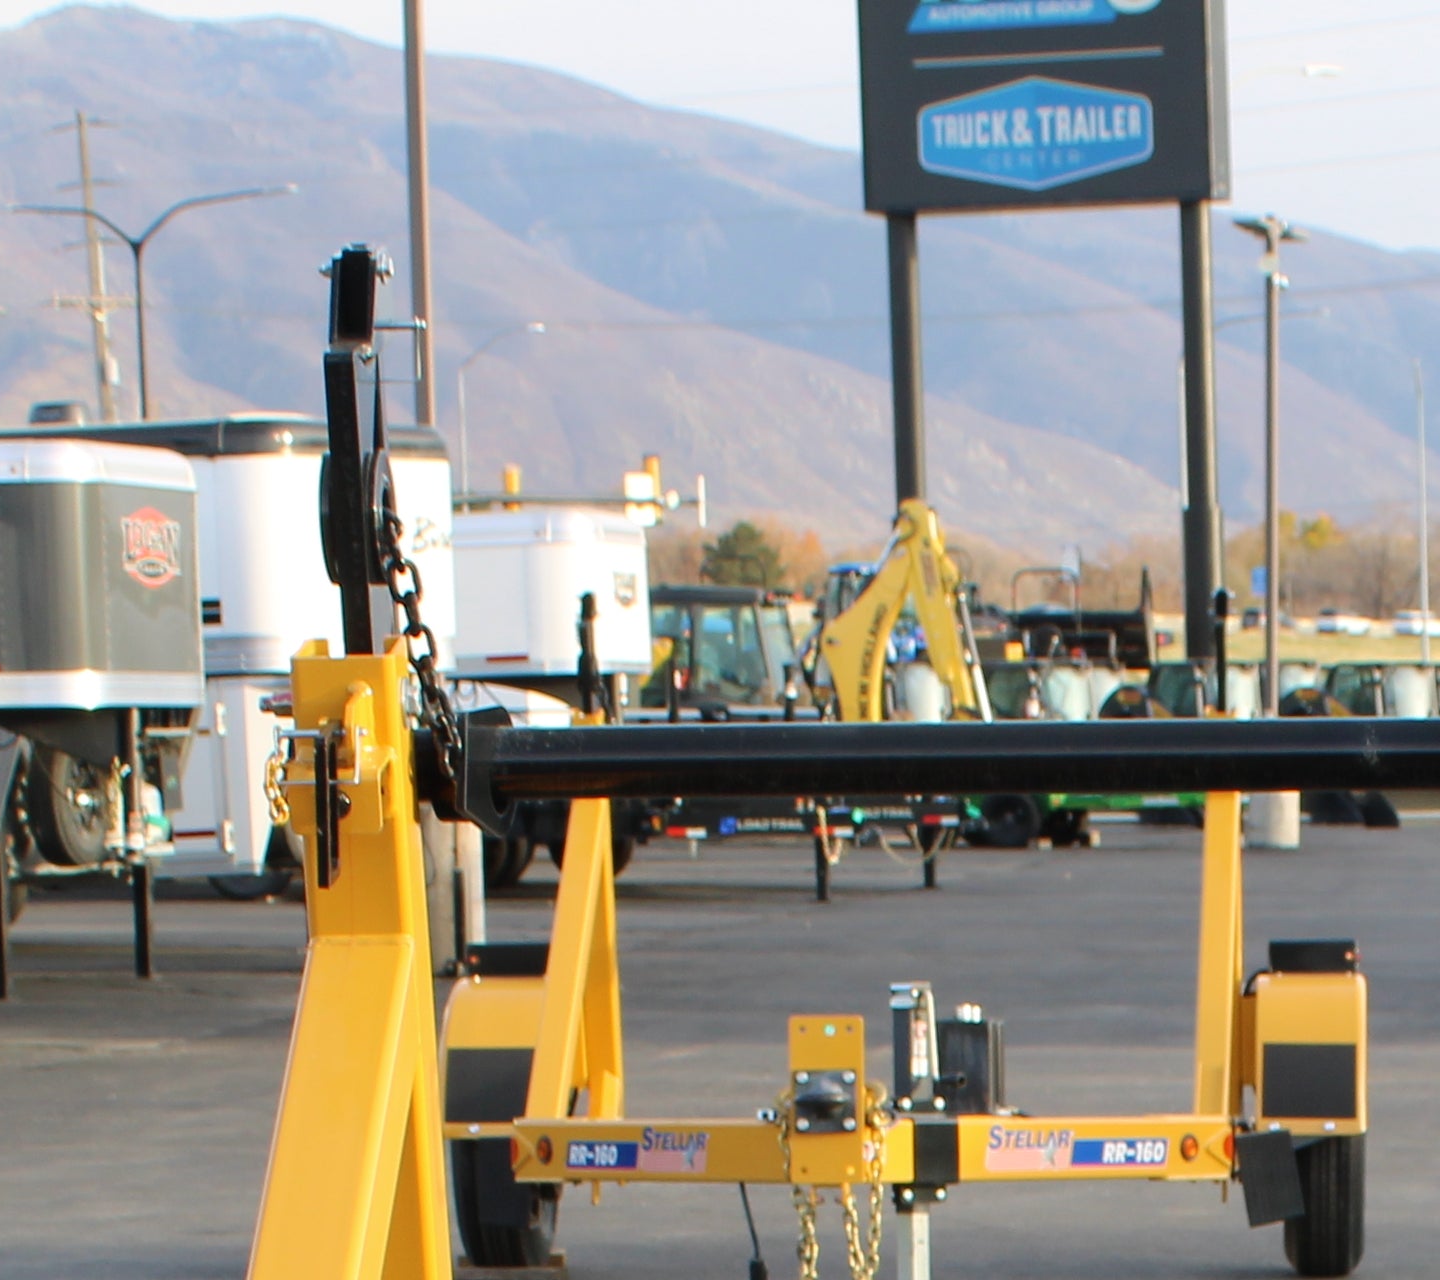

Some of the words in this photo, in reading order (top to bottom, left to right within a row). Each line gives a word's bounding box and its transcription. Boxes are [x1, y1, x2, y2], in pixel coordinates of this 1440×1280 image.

[931, 110, 1009, 148] TRUCK
[1010, 108, 1034, 147] &
[1036, 104, 1142, 144] TRAILER
[988, 149, 1082, 168] CENTER
[642, 1126, 708, 1151] STELLAR
[988, 1125, 1073, 1150] STELLAR
[568, 1143, 619, 1167] RR-160
[1101, 1140, 1166, 1165] RR-160
